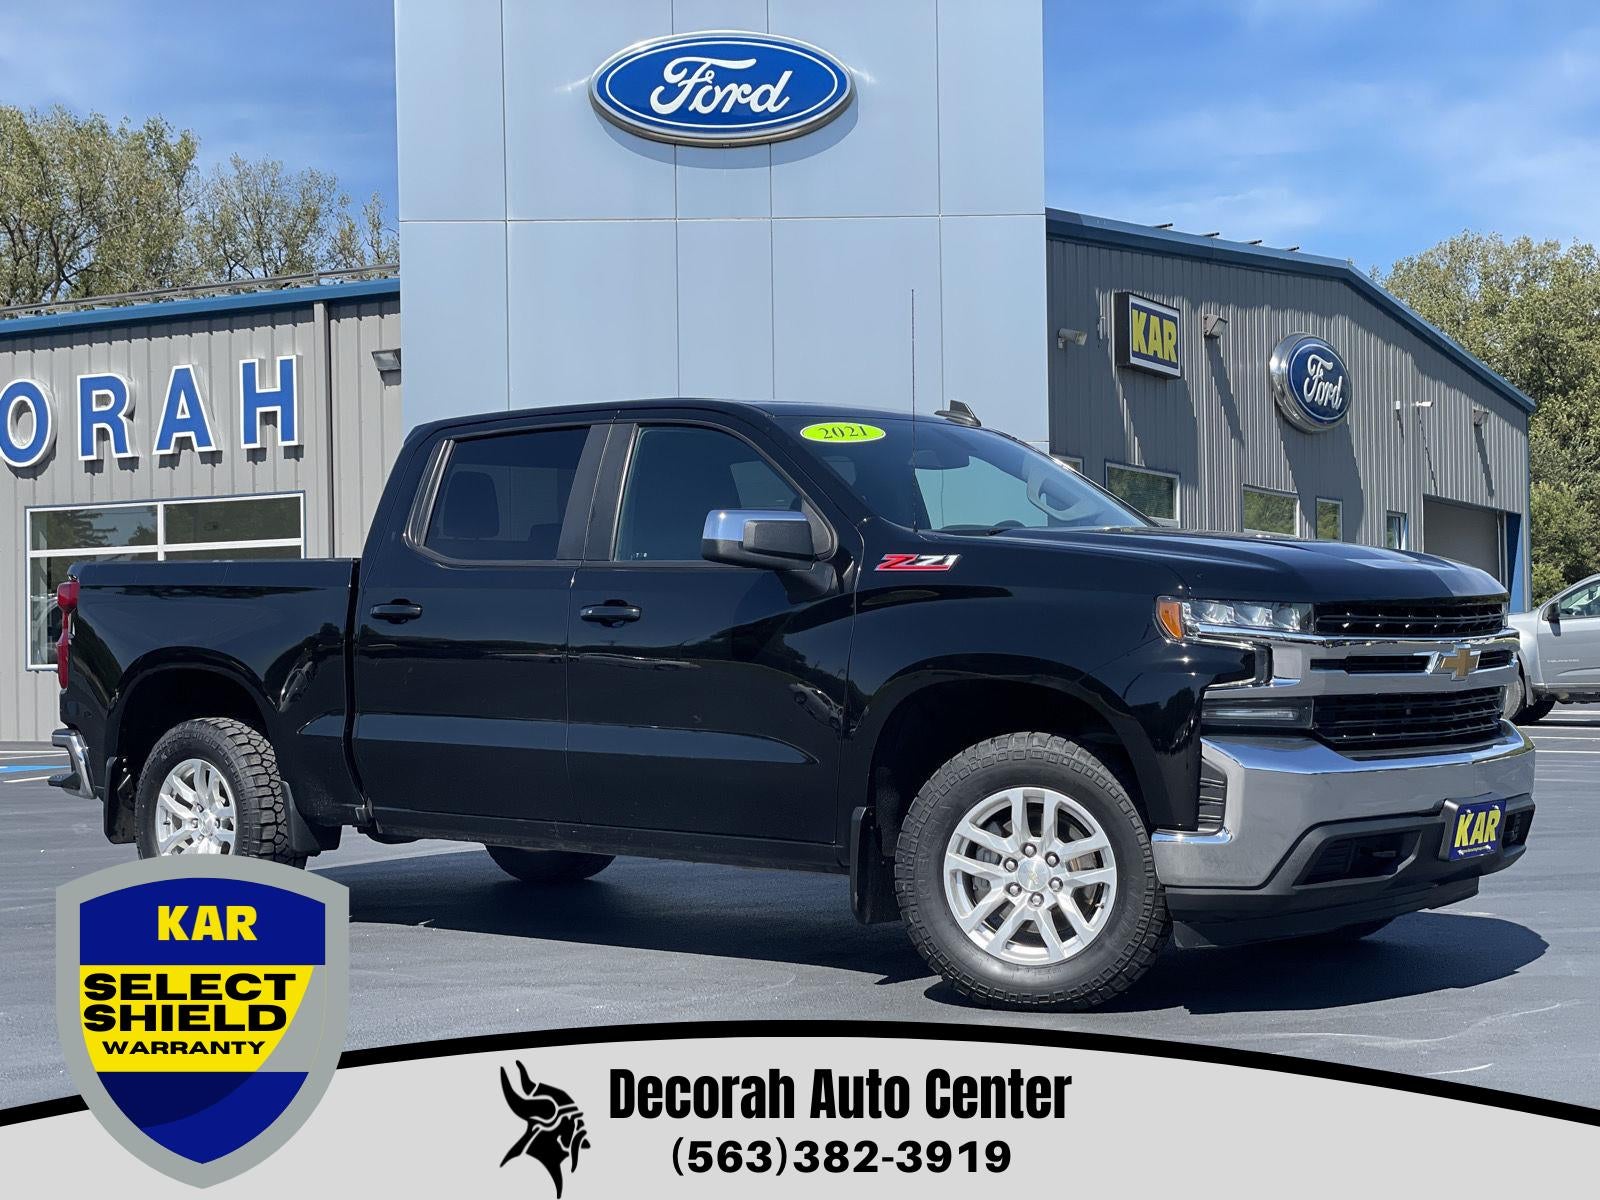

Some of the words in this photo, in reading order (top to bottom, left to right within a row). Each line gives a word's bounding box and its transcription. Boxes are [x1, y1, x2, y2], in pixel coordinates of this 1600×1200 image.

[650, 56, 793, 115] Ford
[1131, 308, 1178, 363] KAR
[1303, 353, 1343, 410] Ford
[0, 355, 299, 468] ORAH
[819, 425, 868, 439] 2021
[874, 553, 961, 572] Z71
[1454, 809, 1501, 848] KAR
